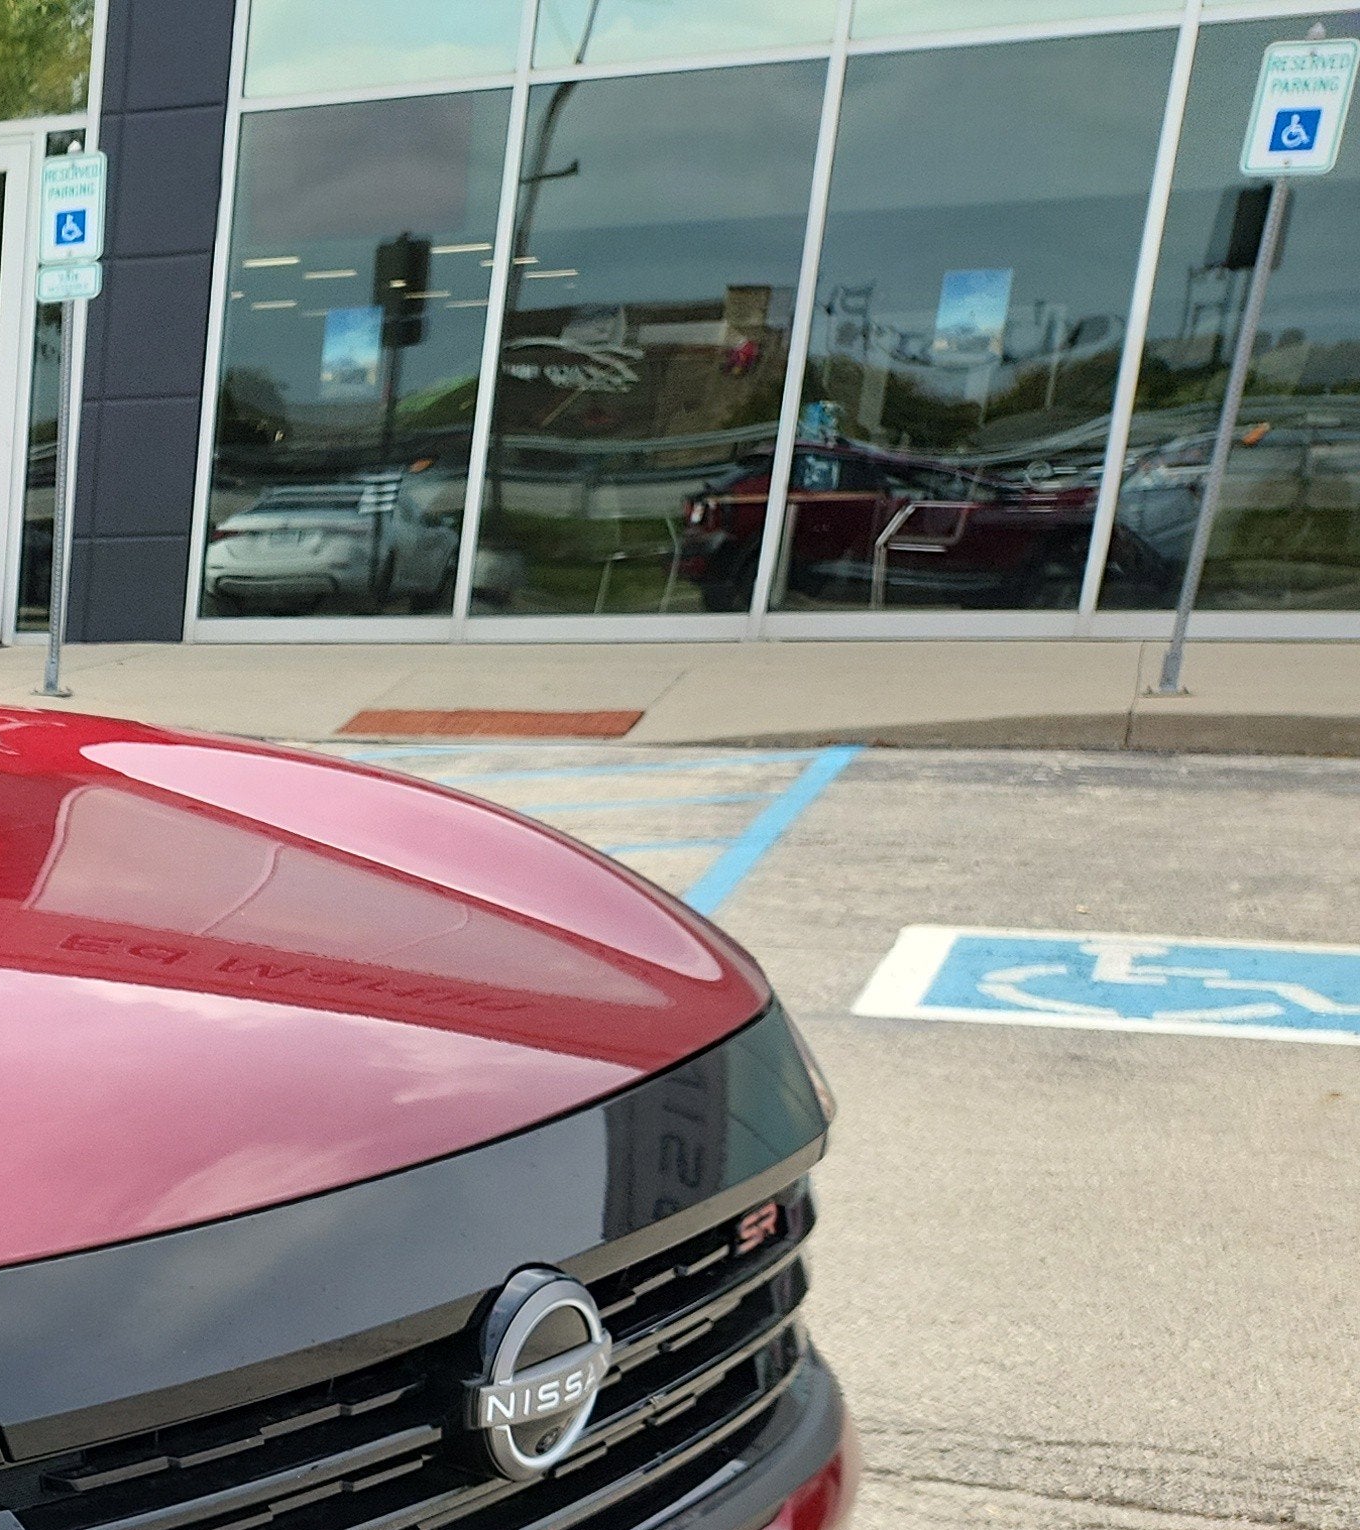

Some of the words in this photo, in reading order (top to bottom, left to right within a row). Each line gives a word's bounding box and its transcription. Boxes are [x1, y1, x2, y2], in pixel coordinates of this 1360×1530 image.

[1268, 53, 1351, 71] RESERVED
[1273, 76, 1340, 92] PARKING
[44, 164, 99, 182] RESERVED
[48, 182, 94, 200] PARKING
[736, 1202, 778, 1256] SR
